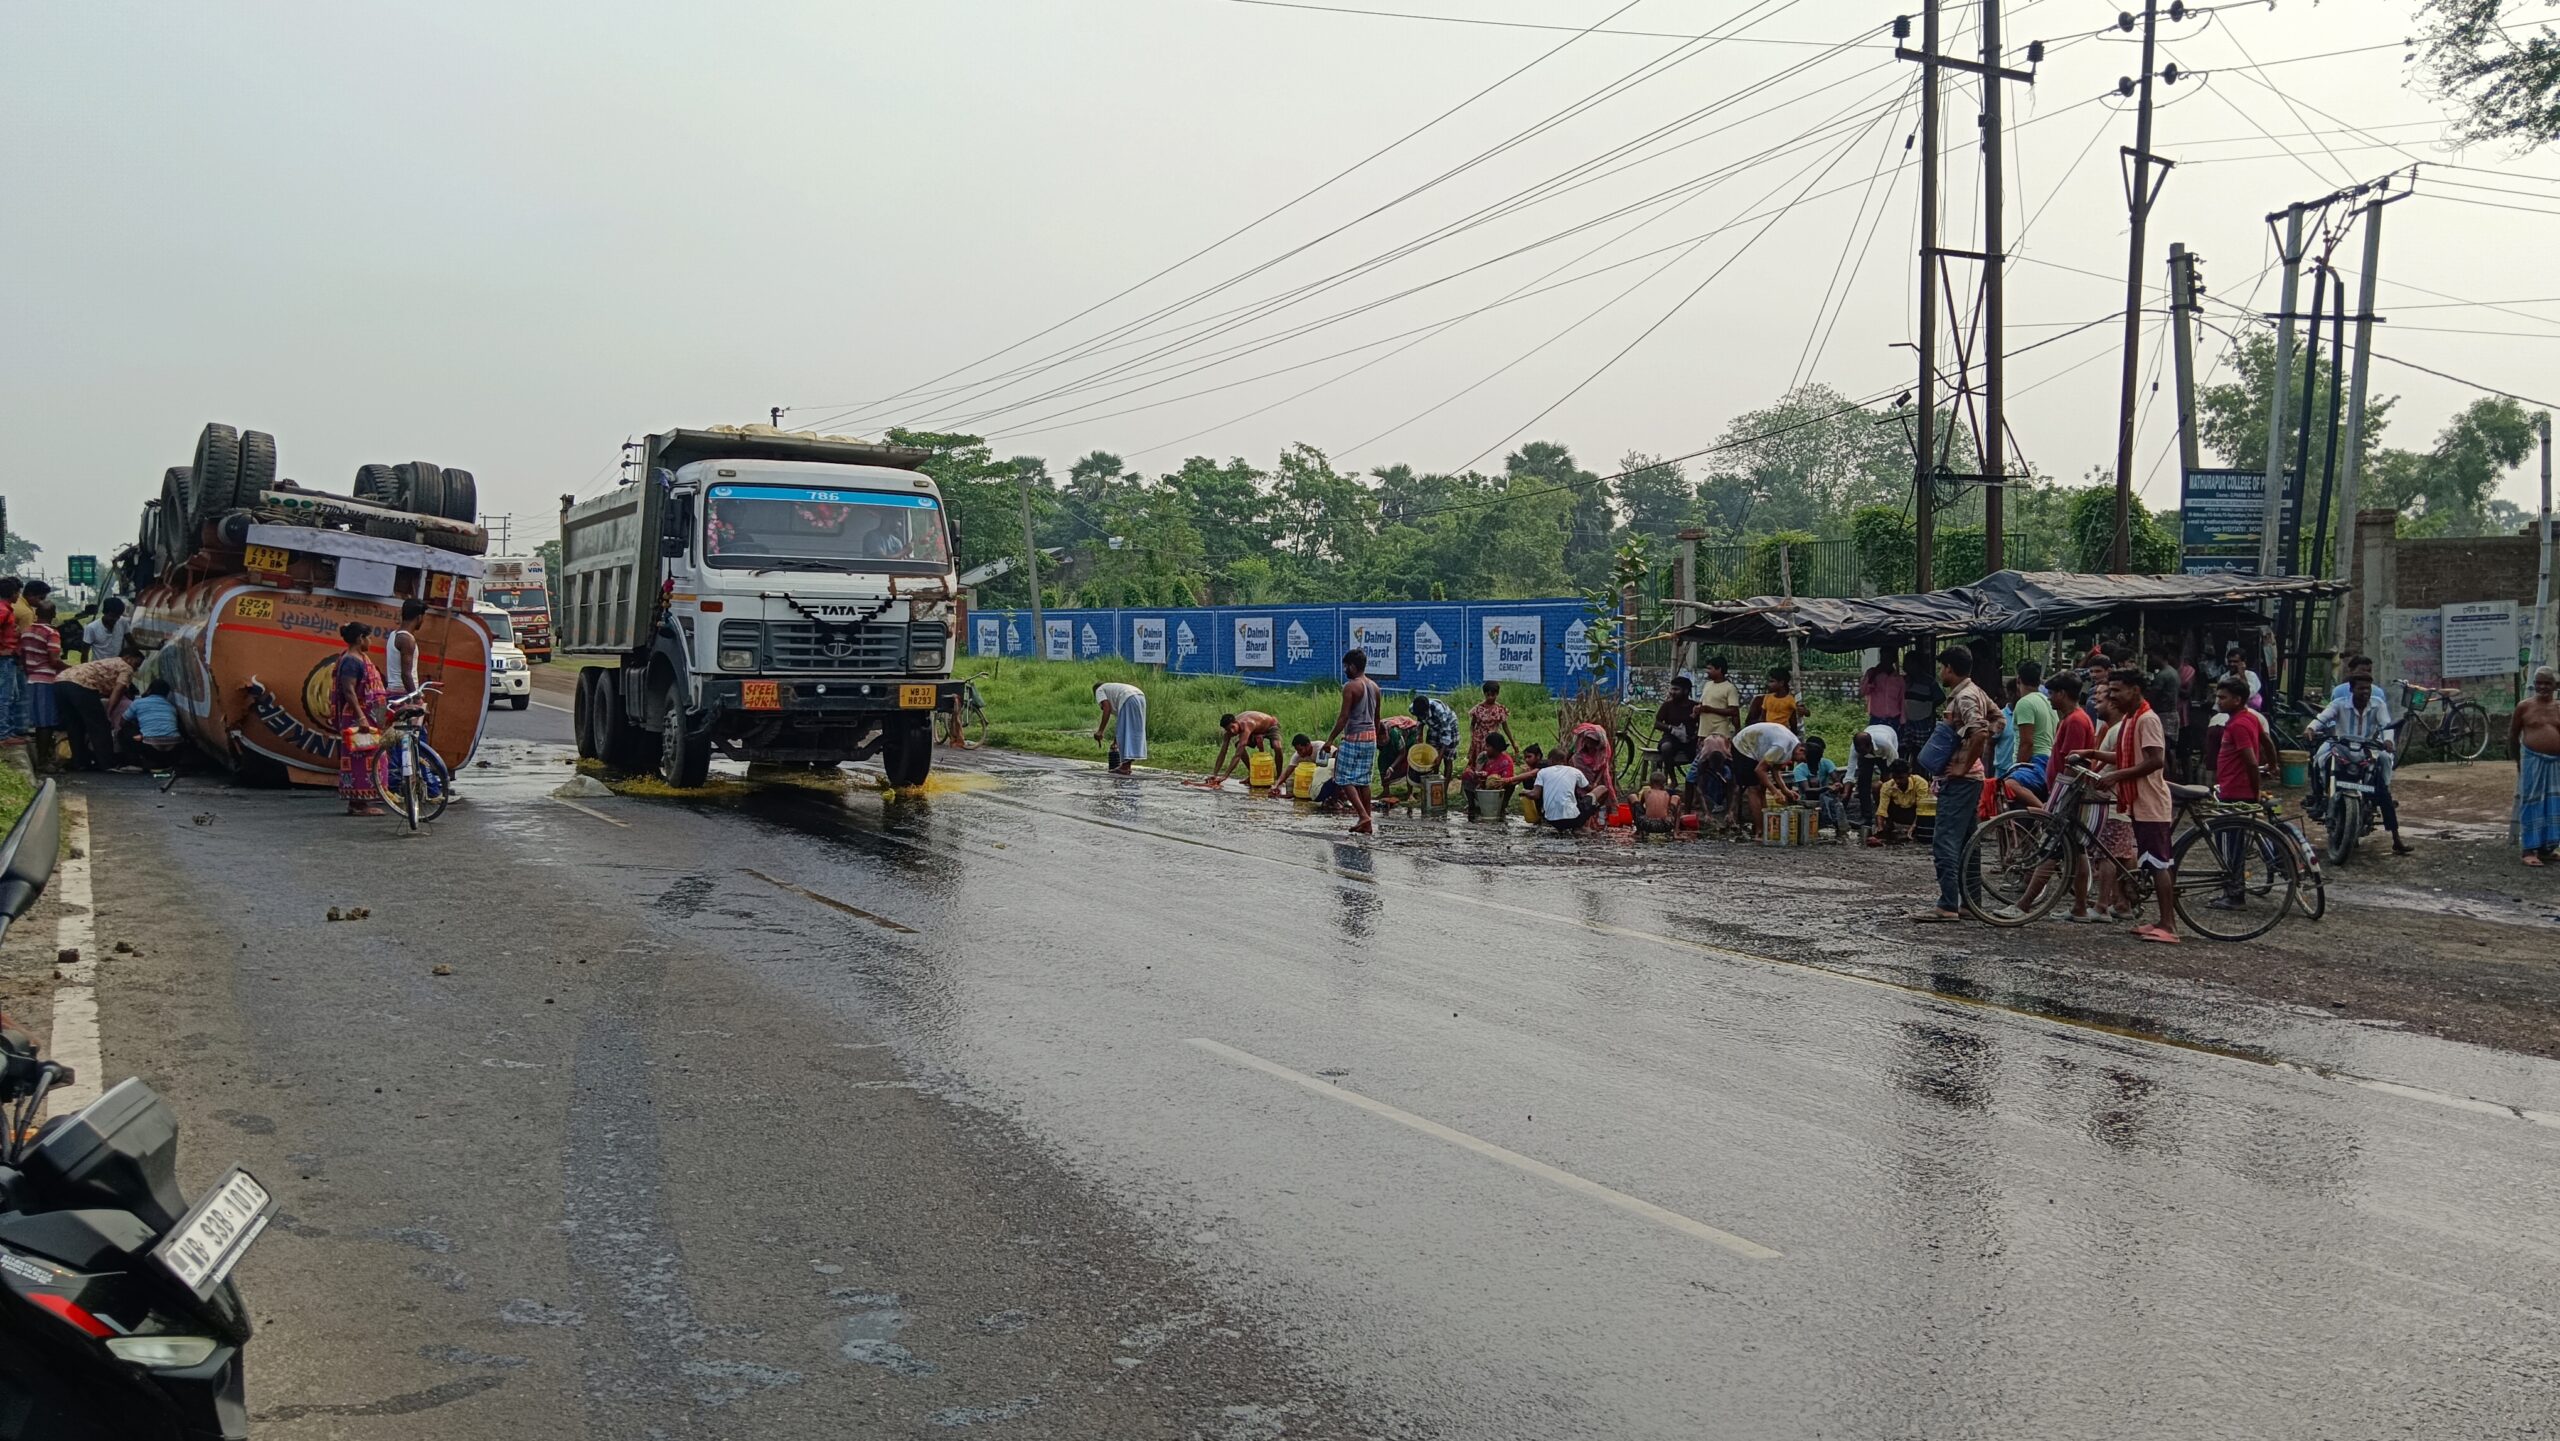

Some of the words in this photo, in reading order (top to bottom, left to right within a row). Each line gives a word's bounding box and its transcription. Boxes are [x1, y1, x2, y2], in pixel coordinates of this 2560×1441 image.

[2189, 474, 2226, 489] MATHURAPUR
[2227, 475, 2252, 490] COLLEGE
[2253, 476, 2260, 490] OF
[805, 491, 840, 501] 786
[252, 547, 284, 560] 4267
[238, 597, 271, 610] 4267
[820, 605, 856, 616] TATA
[1143, 627, 1162, 639] Dalmia
[1246, 627, 1269, 638] Dalmia
[1364, 630, 1392, 644] Dalmia
[1501, 630, 1536, 645] Dalmia
[1142, 640, 1161, 651] Bharat
[1245, 640, 1268, 652] Bharat
[1363, 645, 1390, 658] Bharat
[1287, 648, 1313, 665] EXPERT
[1414, 650, 1448, 671] EXPERT
[1500, 647, 1533, 662] Bharat
[1499, 663, 1523, 672] CEMENT
[910, 687, 920, 696] WB
[921, 687, 931, 696] 37
[179, 1236, 211, 1269] WB
[200, 1208, 235, 1248] 93B
[224, 1175, 263, 1219] 1013
